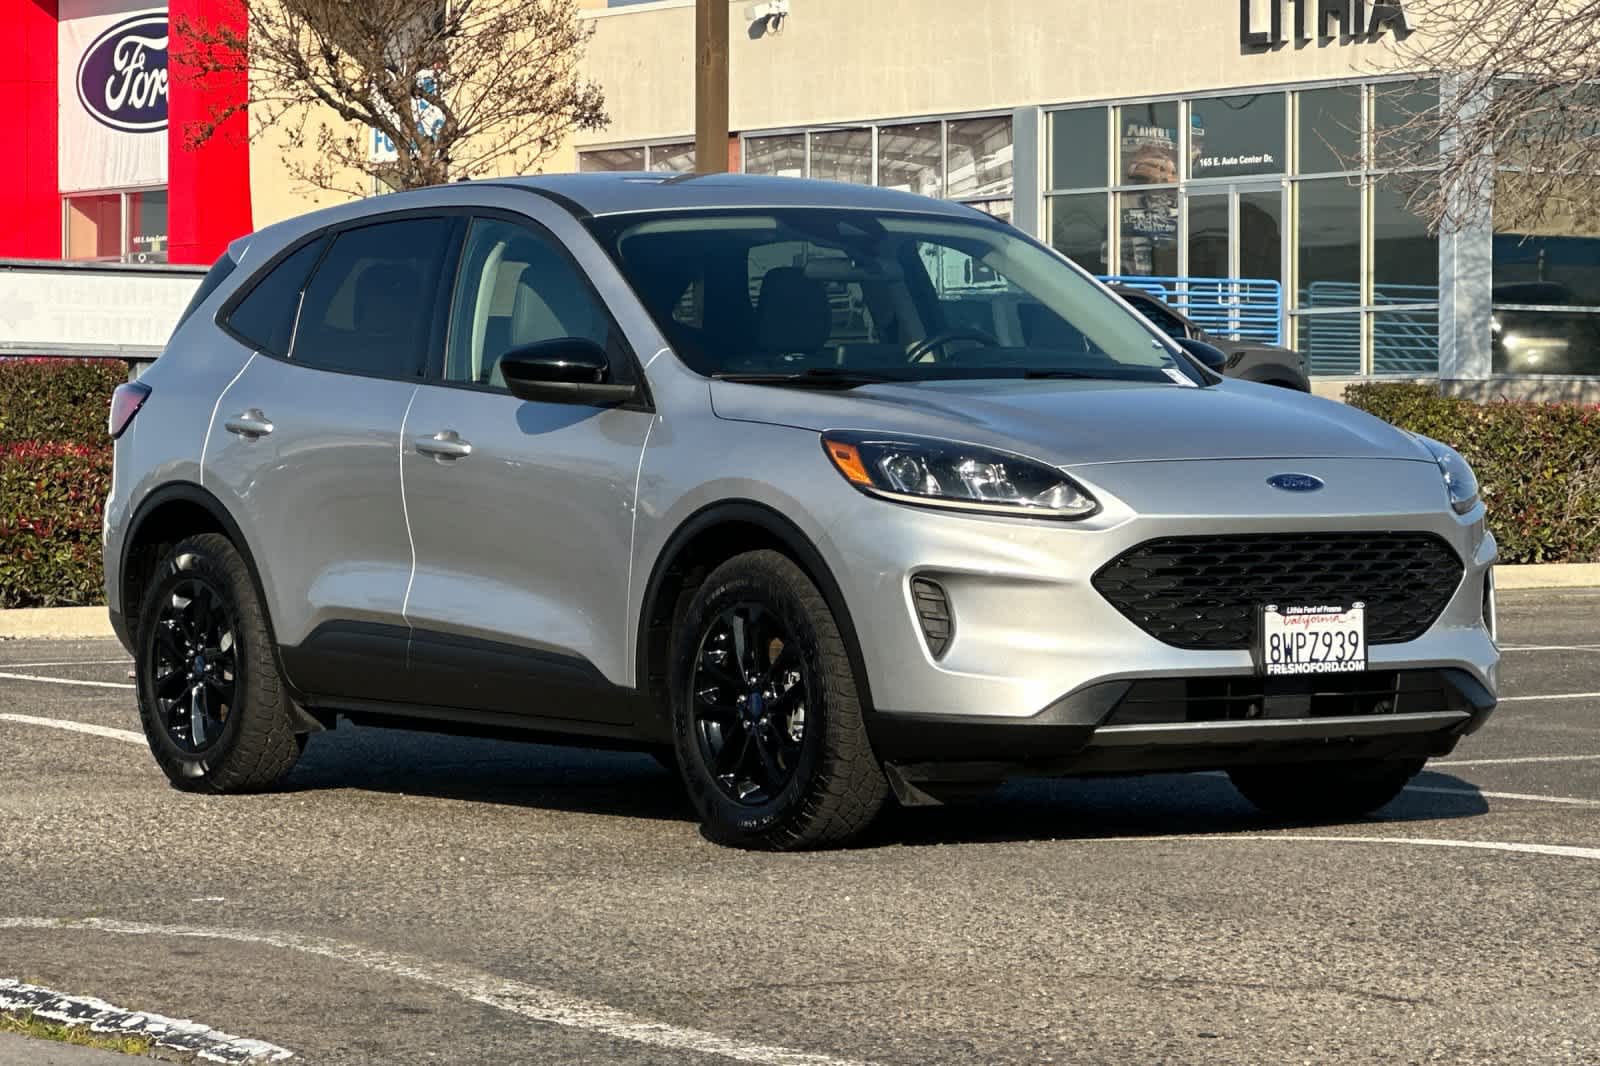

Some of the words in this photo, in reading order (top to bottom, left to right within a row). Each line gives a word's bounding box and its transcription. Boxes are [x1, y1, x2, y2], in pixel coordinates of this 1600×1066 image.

[105, 35, 169, 111] For
[1199, 158, 1212, 167] 165
[1213, 157, 1221, 166] E.
[1222, 156, 1238, 165] Auto
[1239, 155, 1262, 164] Center
[1303, 606, 1316, 614] Ford
[1283, 614, 1346, 630] California
[1267, 661, 1365, 674] FRESNOFORD.COM
